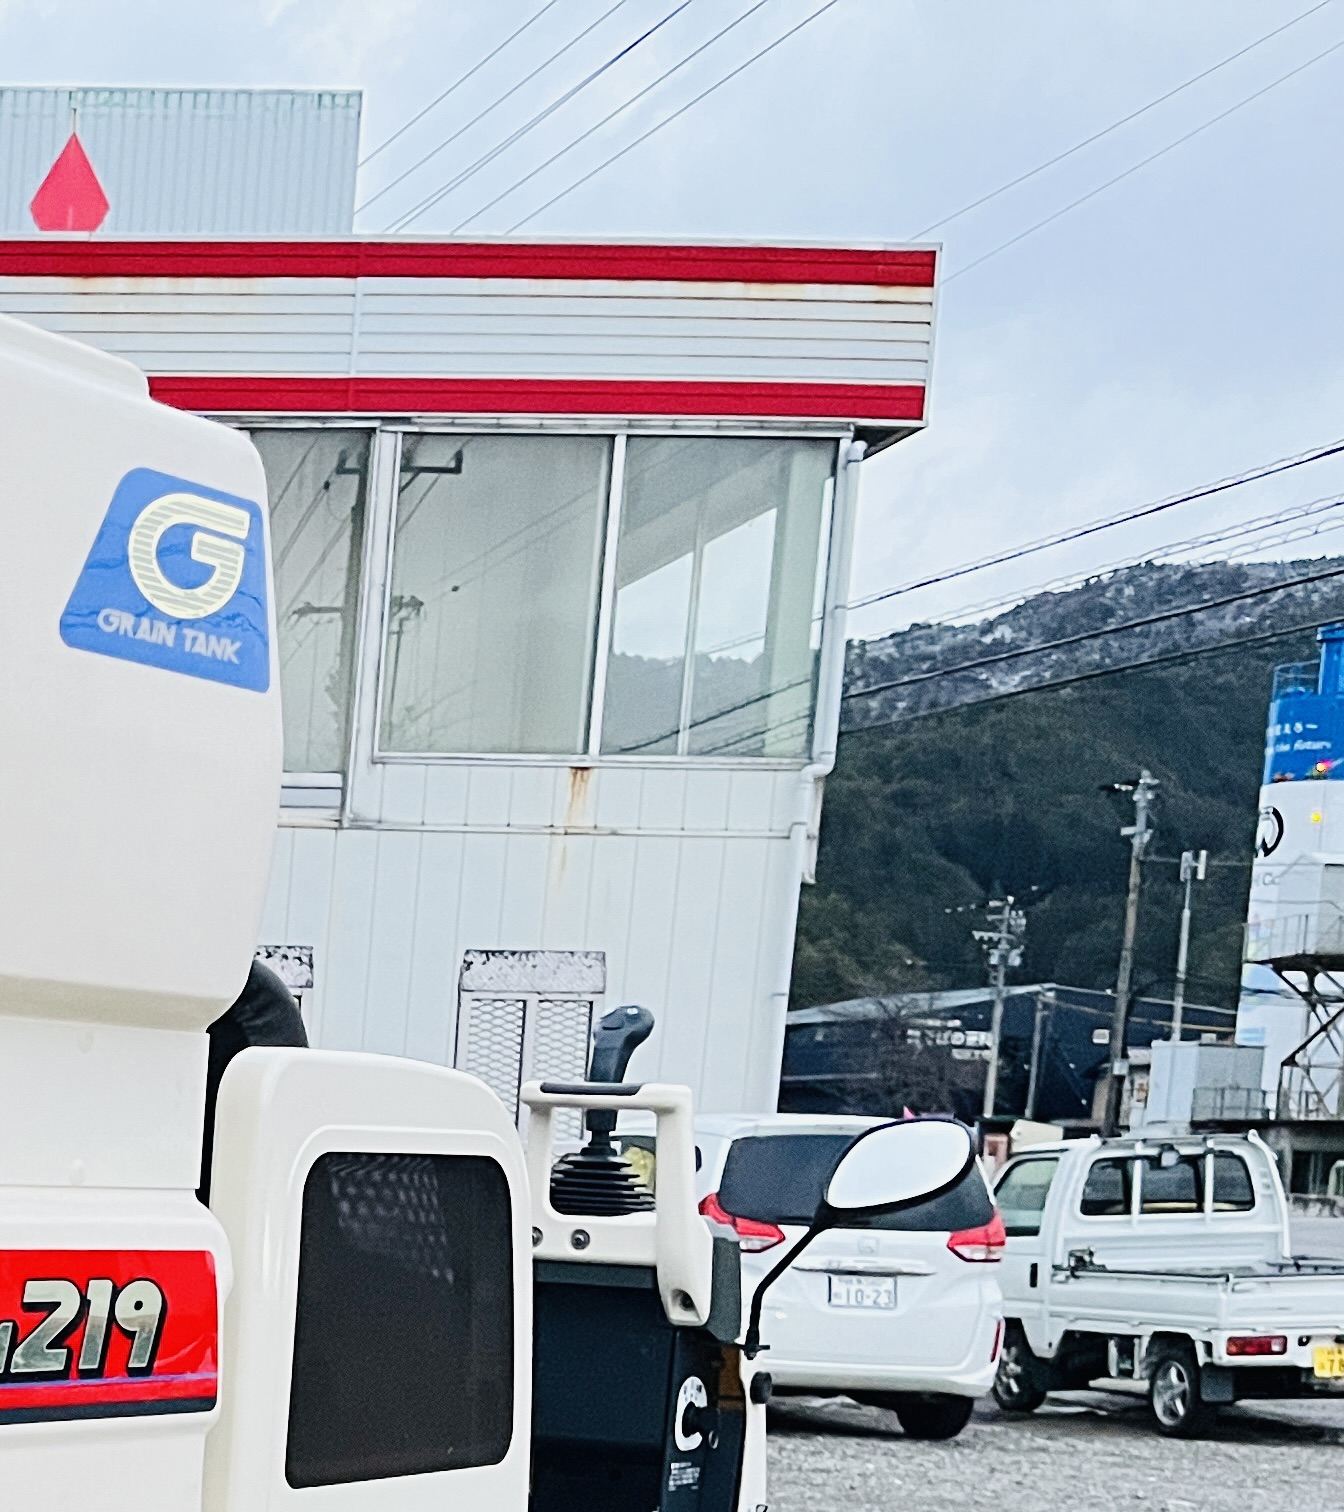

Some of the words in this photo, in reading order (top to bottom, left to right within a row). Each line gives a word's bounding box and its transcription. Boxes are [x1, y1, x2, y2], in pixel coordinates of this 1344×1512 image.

[128, 493, 250, 620] G
[97, 608, 176, 648] GRAIN
[182, 627, 242, 665] TANK
